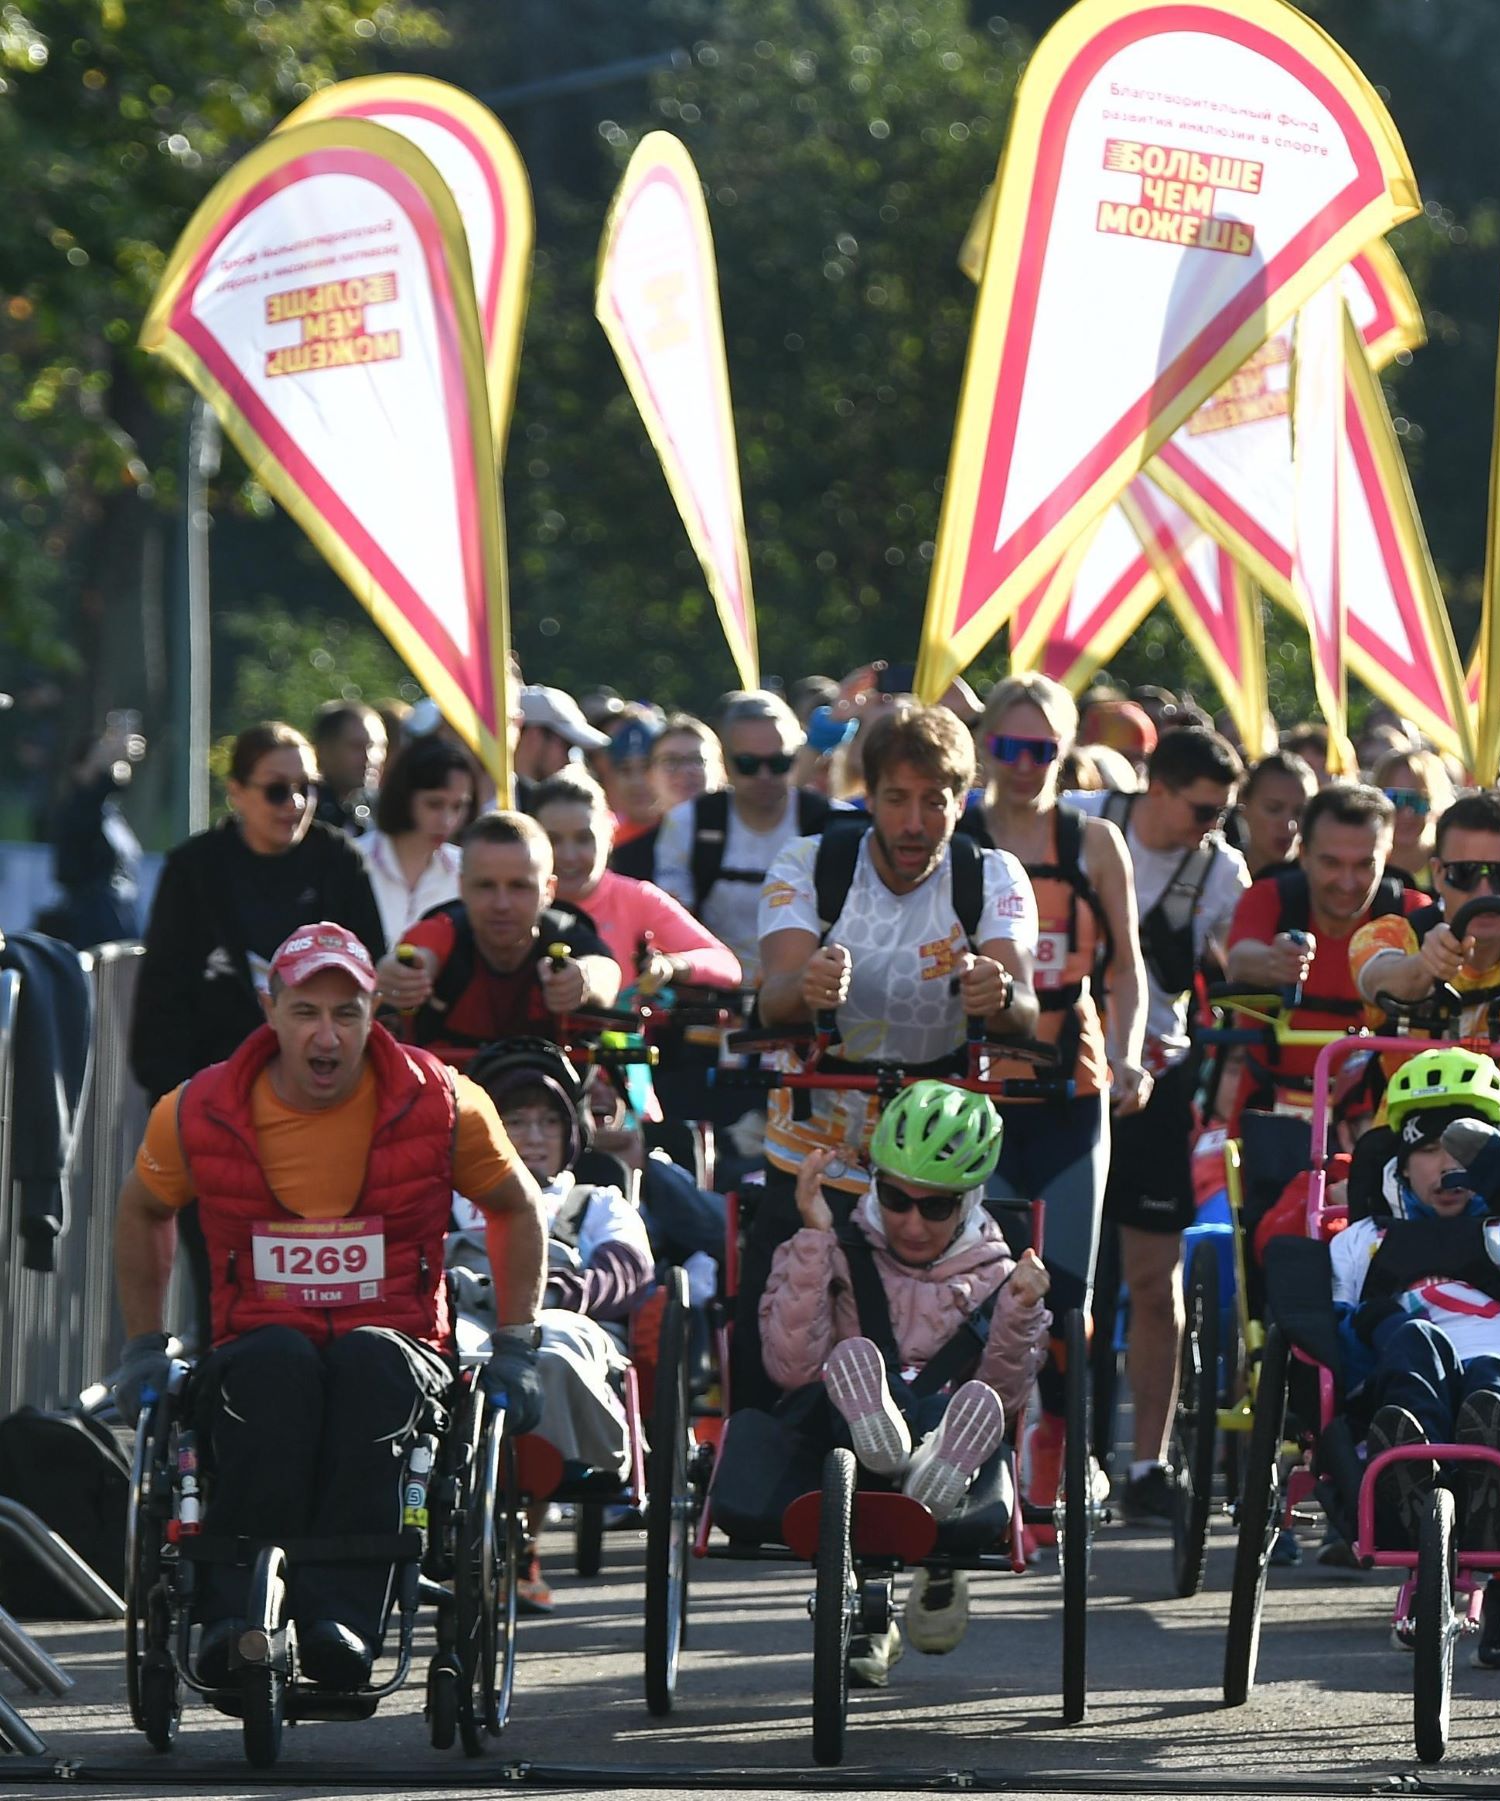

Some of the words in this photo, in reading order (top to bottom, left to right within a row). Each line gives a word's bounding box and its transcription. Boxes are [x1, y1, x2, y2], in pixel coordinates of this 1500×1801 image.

[1106, 140, 1262, 193] БОЛЬШЕ
[1143, 177, 1214, 216] ЧЕМ
[1098, 202, 1253, 256] МОЖЕШЬ
[269, 1244, 368, 1275] 1269
[301, 1288, 316, 1301] 11
